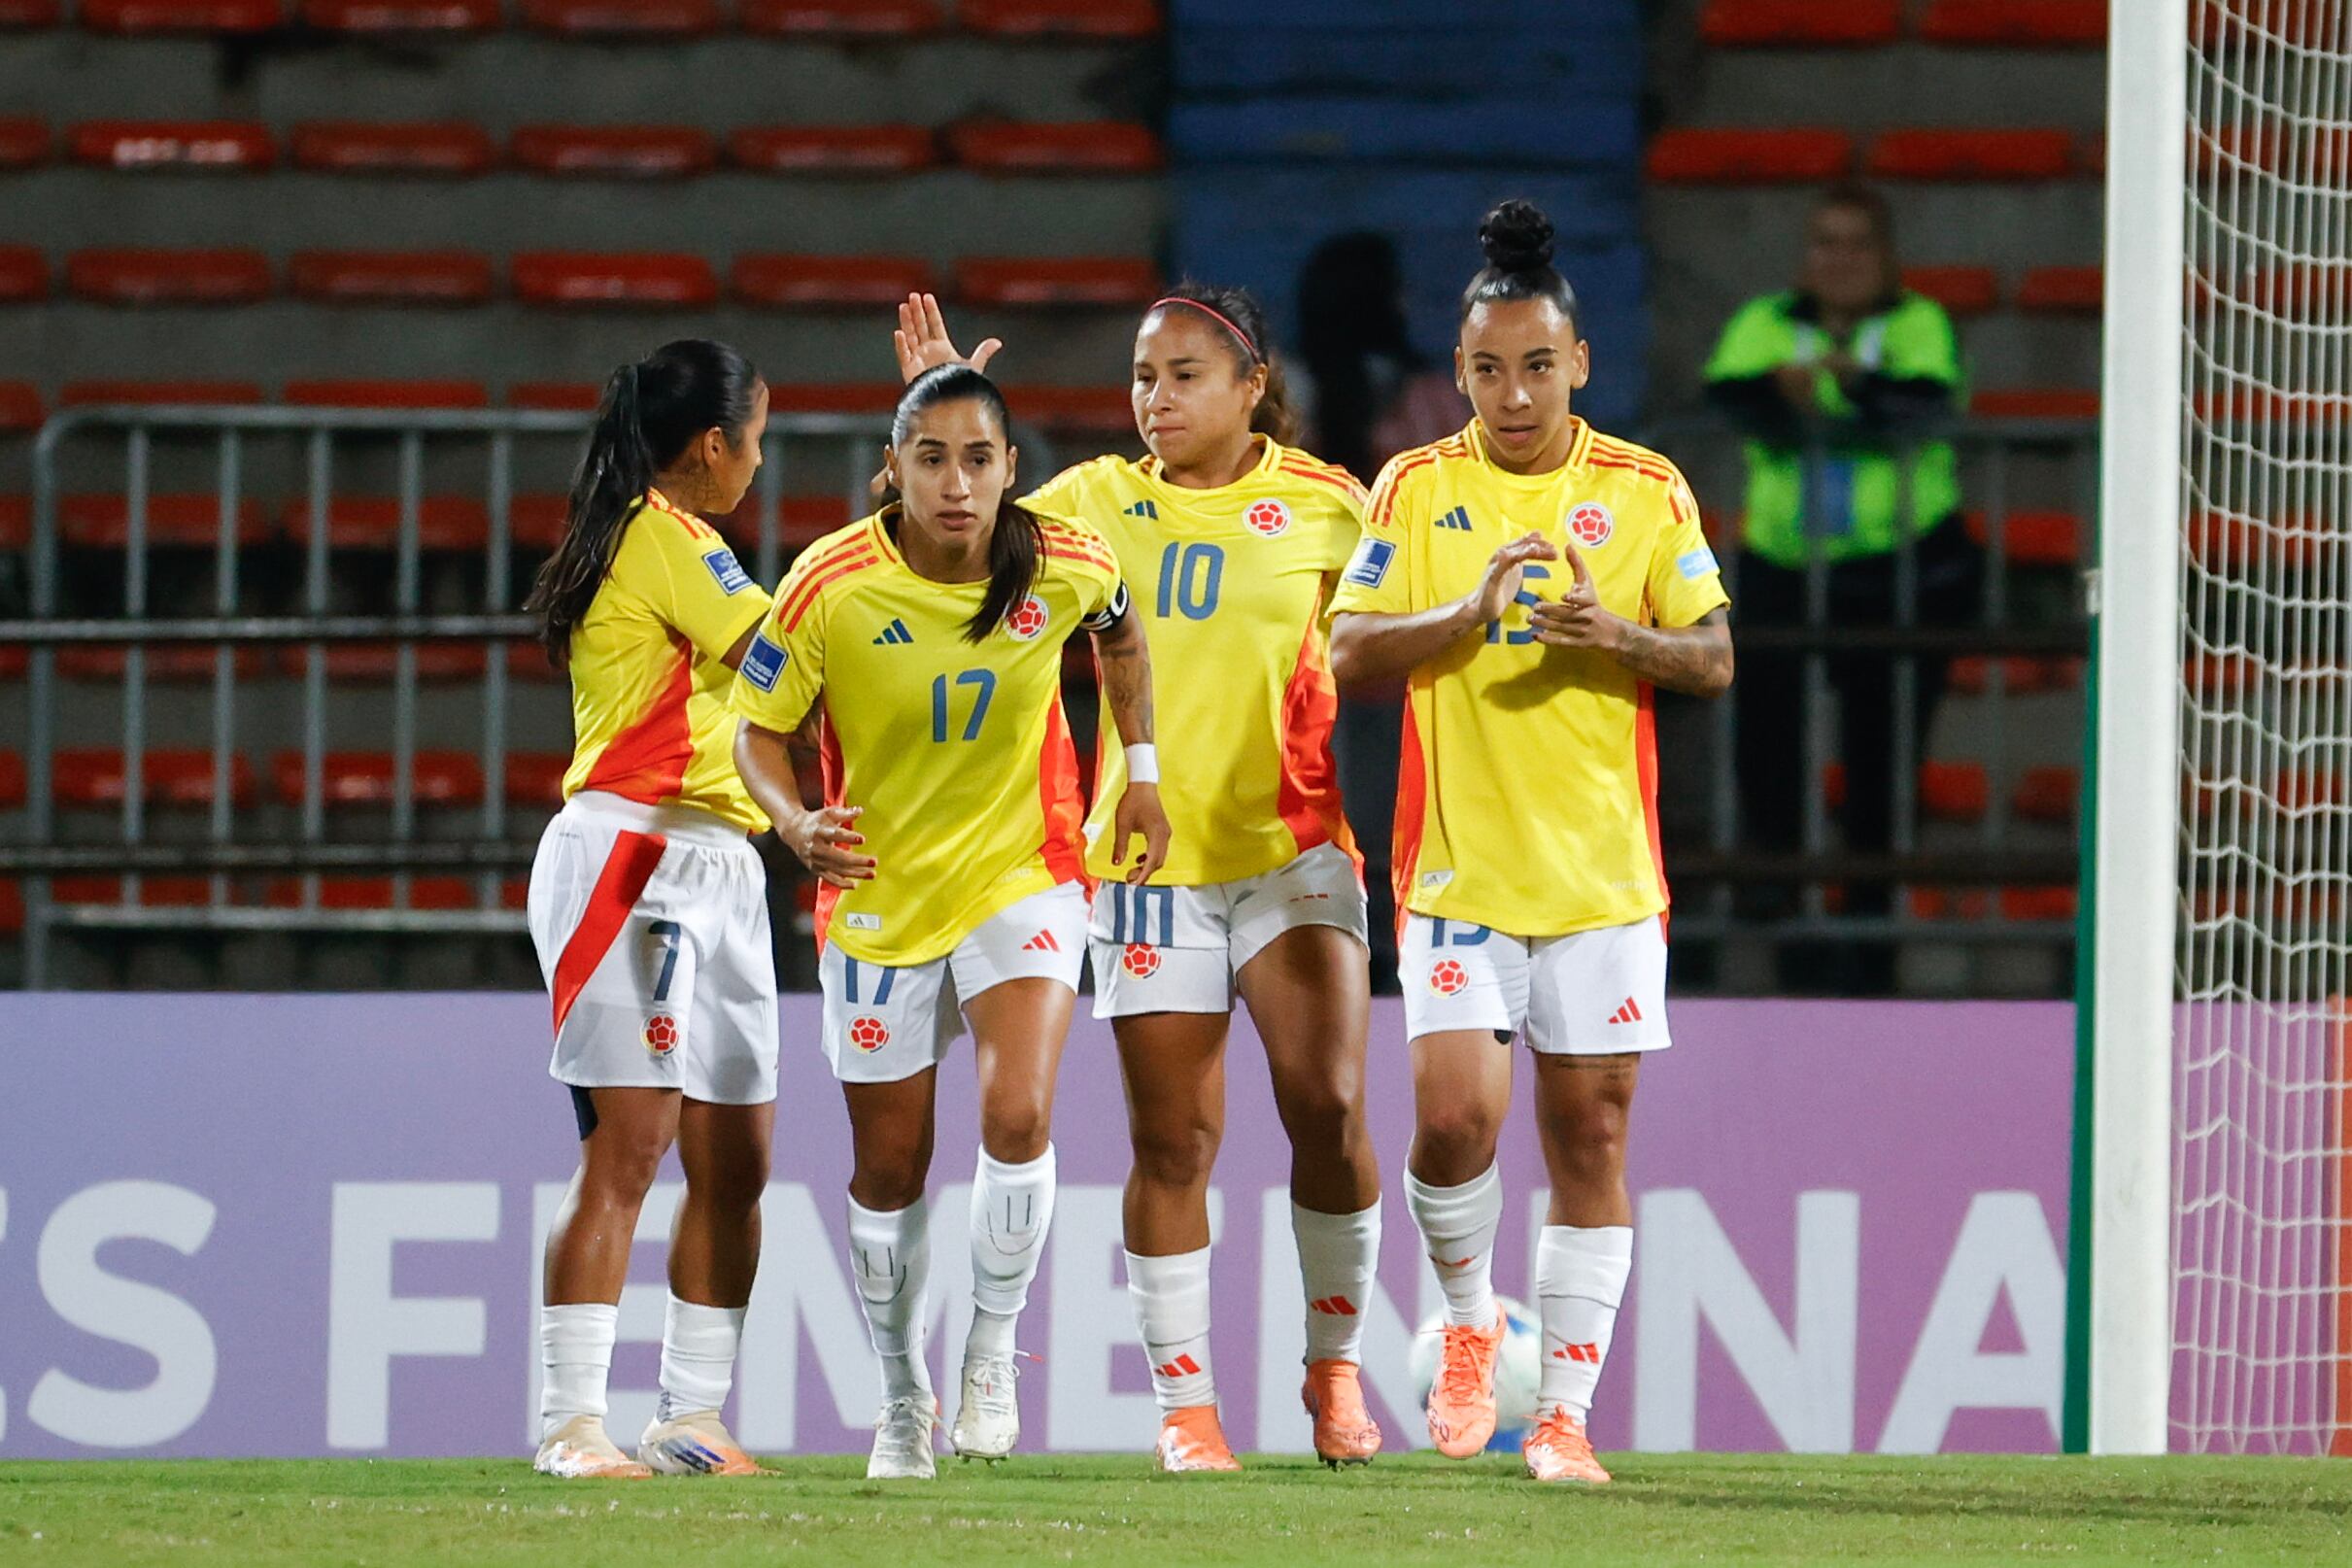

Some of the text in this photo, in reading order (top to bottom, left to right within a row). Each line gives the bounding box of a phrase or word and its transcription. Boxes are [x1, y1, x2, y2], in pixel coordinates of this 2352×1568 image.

[1157, 541, 1225, 621] 10
[1486, 564, 1551, 645] 5
[933, 667, 997, 743] 17
[648, 919, 682, 1002] 7
[0, 1178, 2067, 1454] S FMENNA
